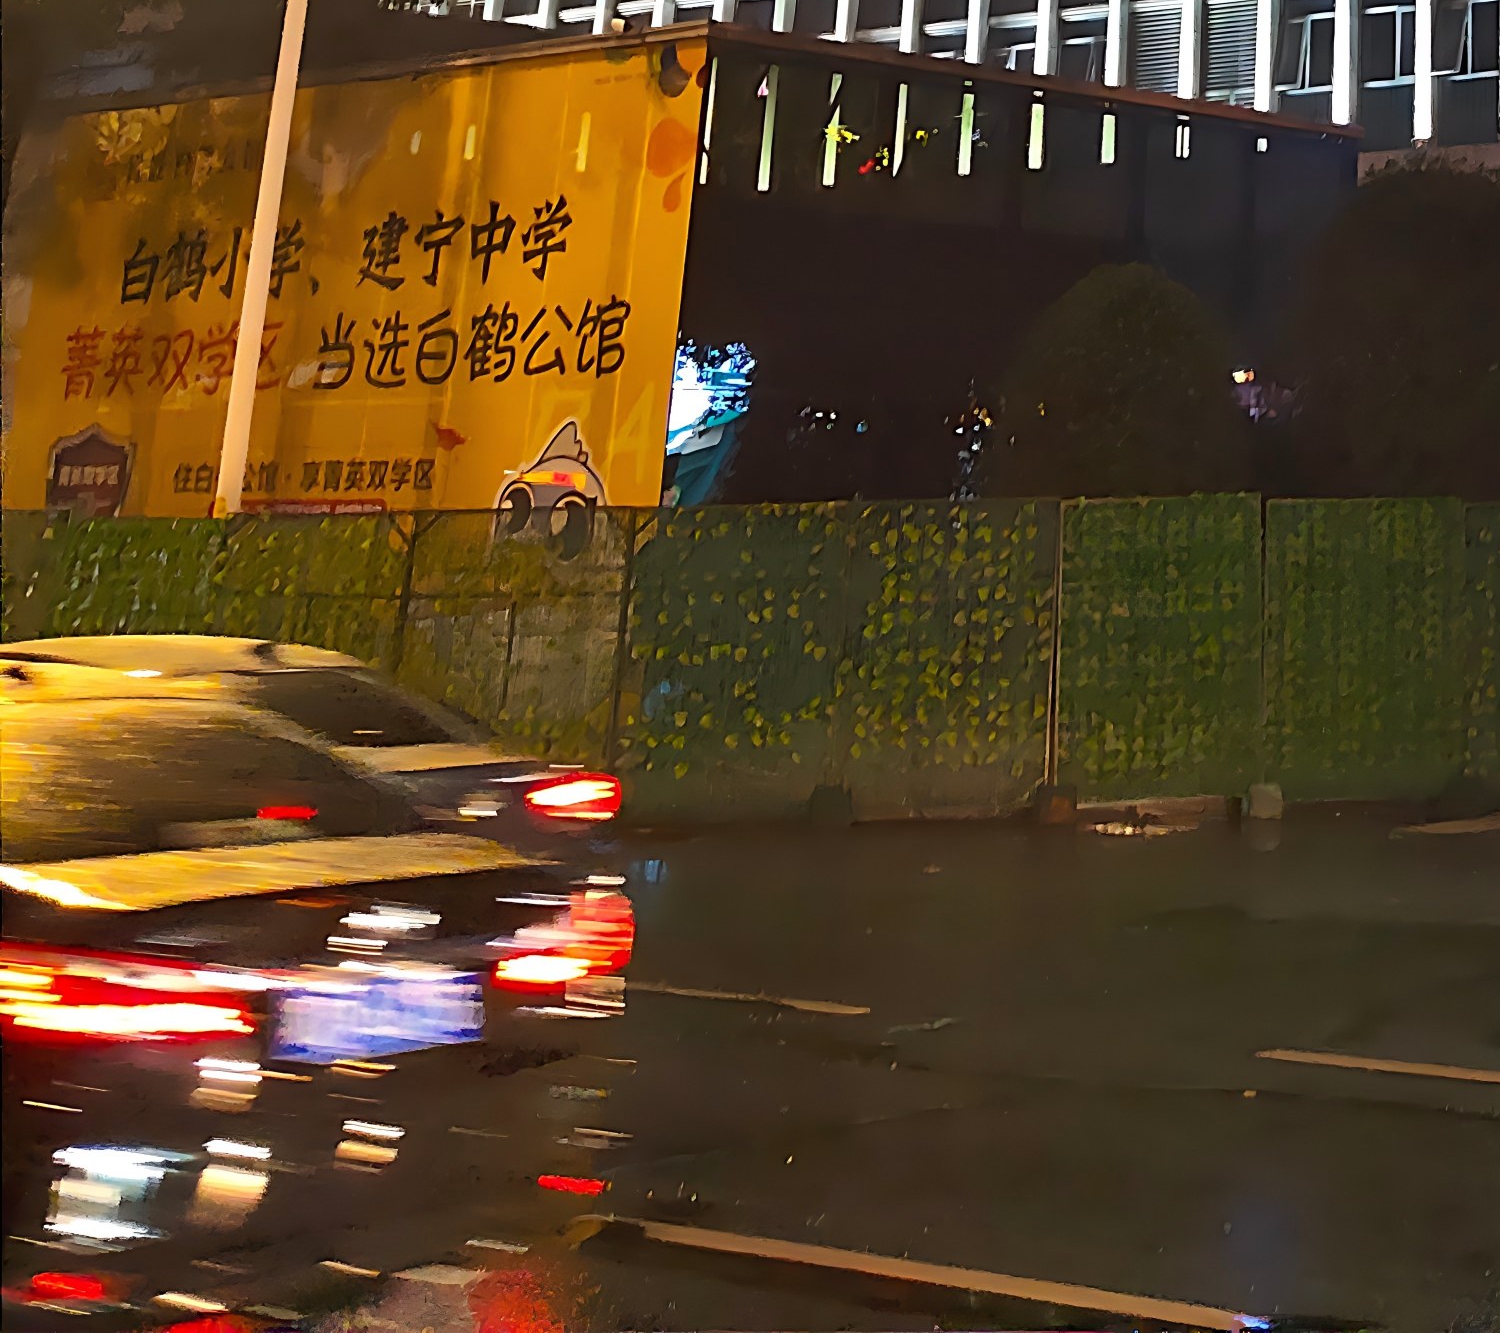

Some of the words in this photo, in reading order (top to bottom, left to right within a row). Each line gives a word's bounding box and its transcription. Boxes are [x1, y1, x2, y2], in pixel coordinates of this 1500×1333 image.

[312, 294, 631, 390] 当选白鹤公馆
